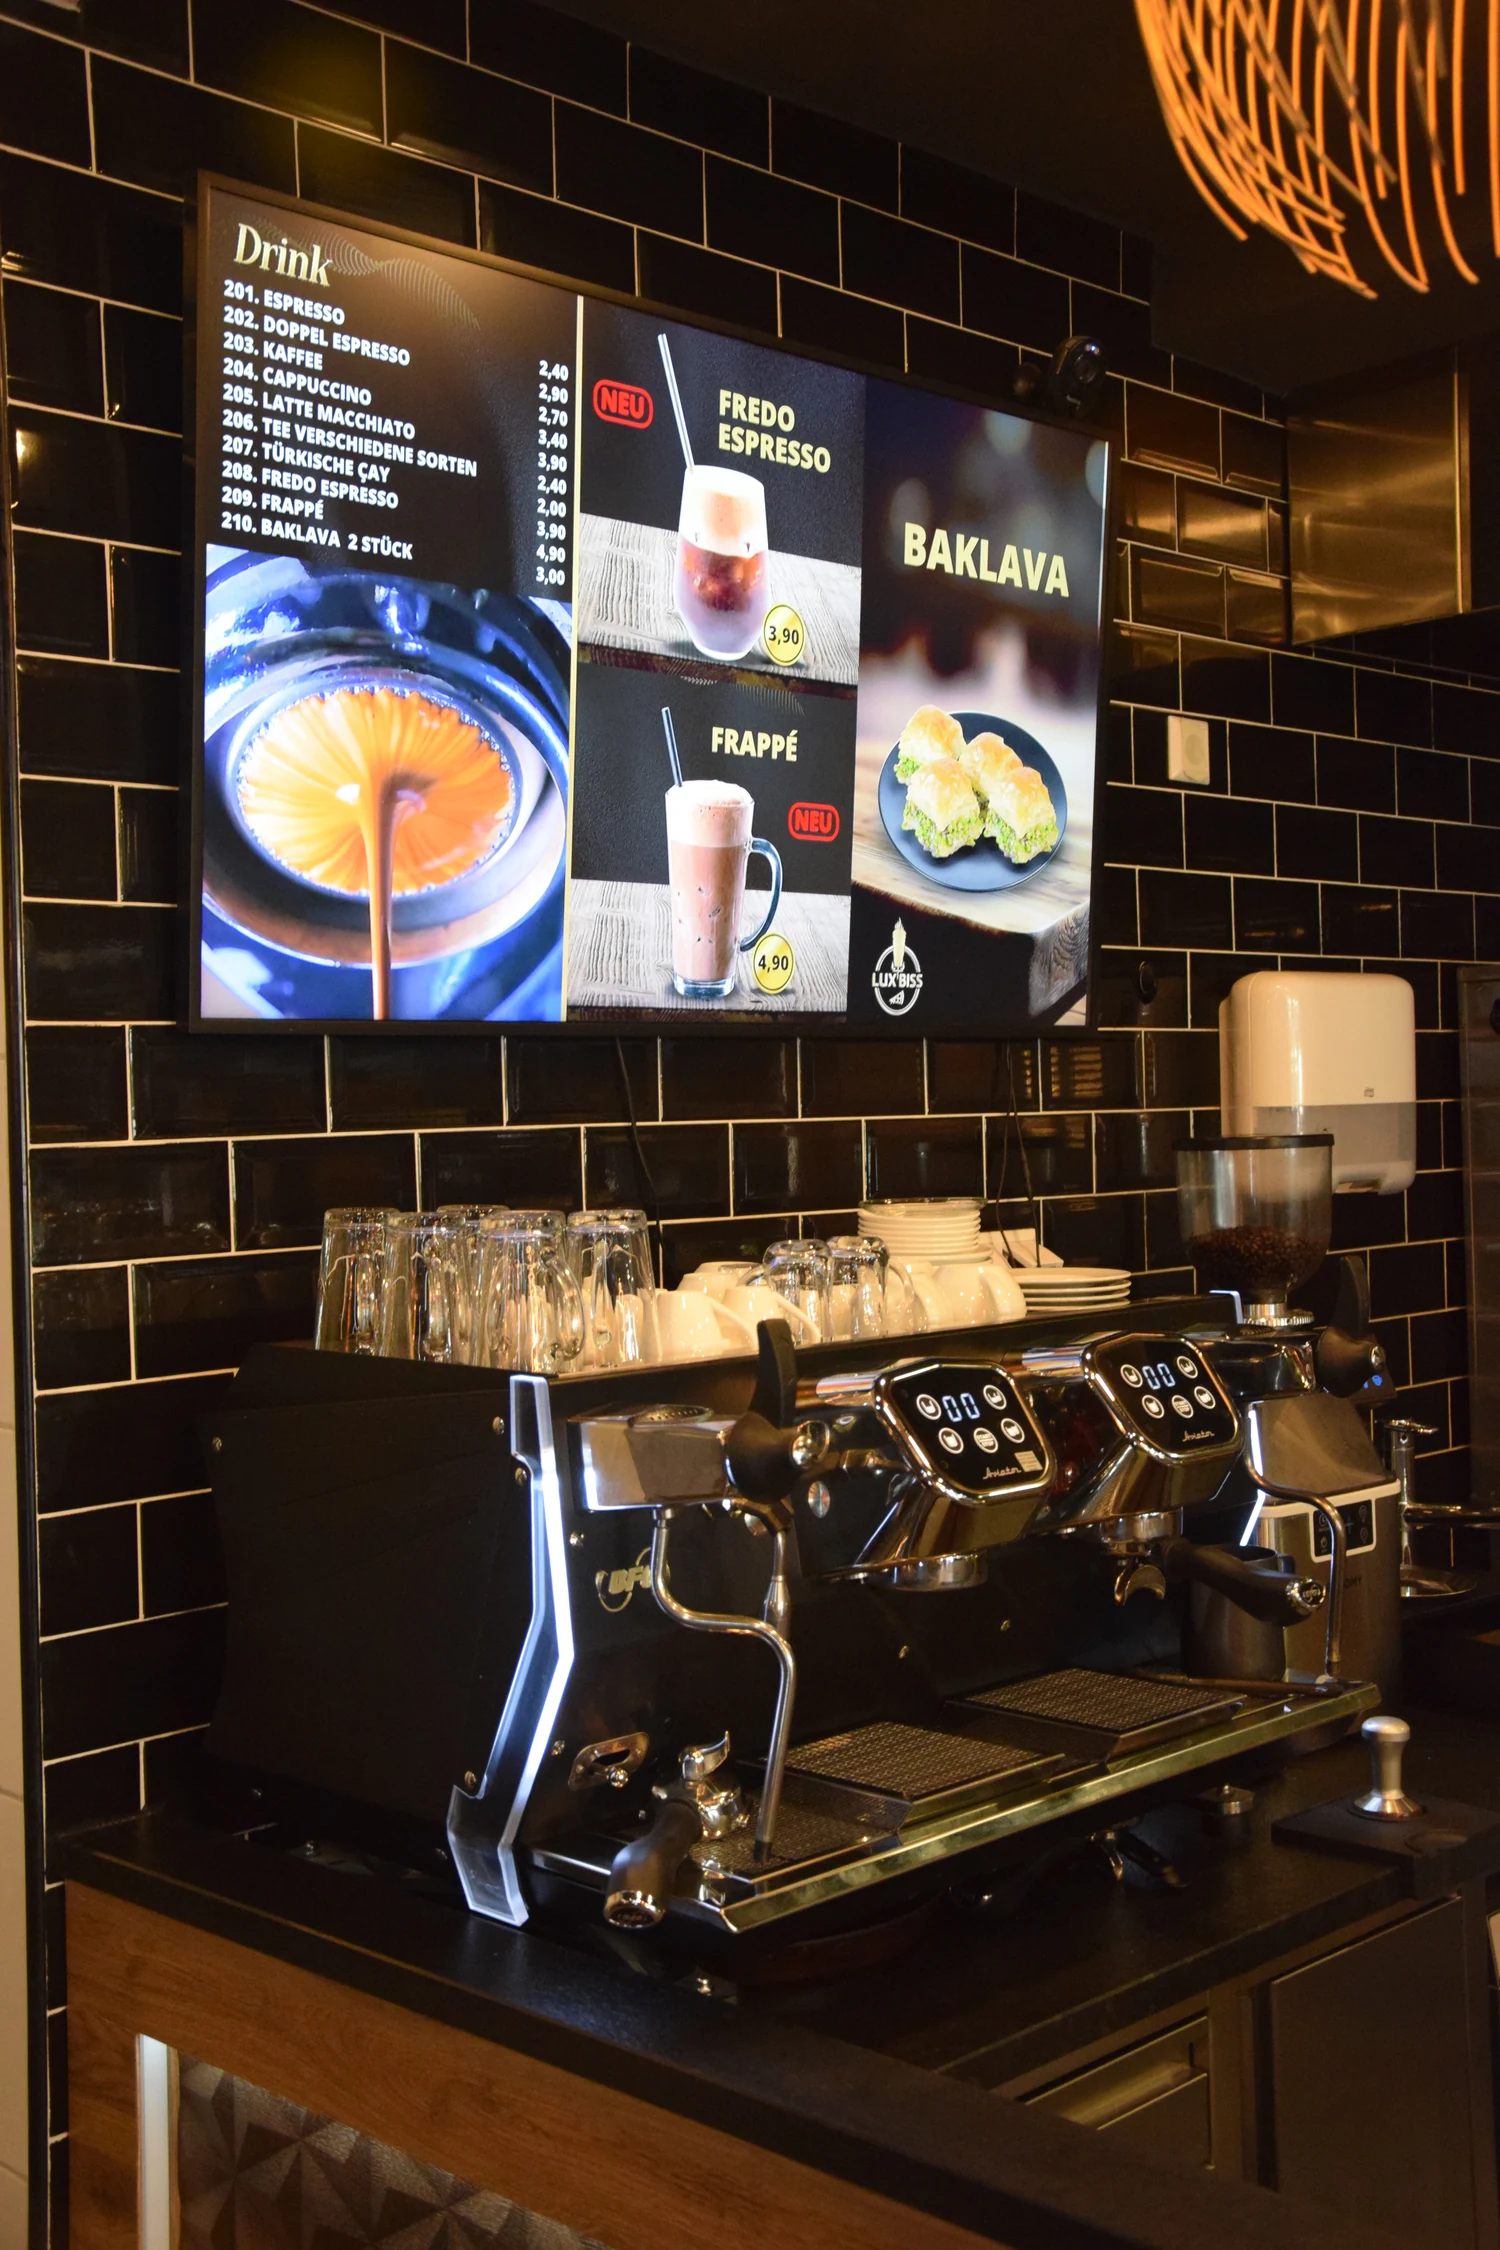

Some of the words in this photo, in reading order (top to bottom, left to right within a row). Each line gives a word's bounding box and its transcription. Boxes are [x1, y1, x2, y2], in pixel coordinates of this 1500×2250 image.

[234, 223, 332, 287] Drink
[224, 280, 259, 304] 201.
[264, 290, 345, 325] ESPRESSO
[223, 332, 259, 356] 203.
[263, 341, 323, 371] KAFFEE
[224, 306, 259, 330] 202.
[263, 316, 328, 347] DOPPEL
[333, 333, 410, 366] ESPRESSO
[223, 358, 259, 381] 204.
[263, 367, 371, 405] CAPPUCCINO
[539, 360, 569, 381] 2,40
[539, 383, 568, 404] 2,90
[601, 388, 645, 419] NEU
[719, 389, 795, 432] FREDO
[223, 384, 258, 407] 205.
[263, 392, 313, 419] LATTE
[317, 405, 415, 440] MACCHIATO
[538, 407, 568, 427] 2,70
[222, 410, 258, 433] 206.
[262, 417, 291, 440] TEE
[295, 425, 413, 463] VERSCHIEDENE
[417, 450, 477, 476] SORTEN
[538, 429, 568, 450] 3,40
[719, 423, 831, 473] ESPRESSO
[222, 436, 258, 459] 207.
[262, 441, 353, 477] TÜRKISCHE
[358, 462, 390, 483] ÇAY
[538, 452, 567, 472] 3,90
[222, 461, 257, 484] 208.
[262, 470, 316, 493] FREDO
[321, 480, 399, 509] ESPRESSO
[537, 475, 567, 495] 2,40
[222, 486, 257, 509] 209.
[261, 495, 325, 520] FRAPPÉ
[537, 498, 566, 518] 2,00
[221, 512, 256, 534] 210.
[261, 519, 340, 548] BAKLAVA
[348, 533, 357, 550] 2
[361, 534, 413, 560] STÜCK
[537, 521, 566, 540] 3,90
[536, 544, 566, 563] 4,90
[904, 522, 1069, 597] BAKLAVA
[536, 567, 565, 585] 3,00
[769, 625, 799, 646] 3,90
[712, 727, 798, 762] FRAPPÉ
[795, 810, 832, 834] NEU
[758, 955, 788, 972] 4,90
